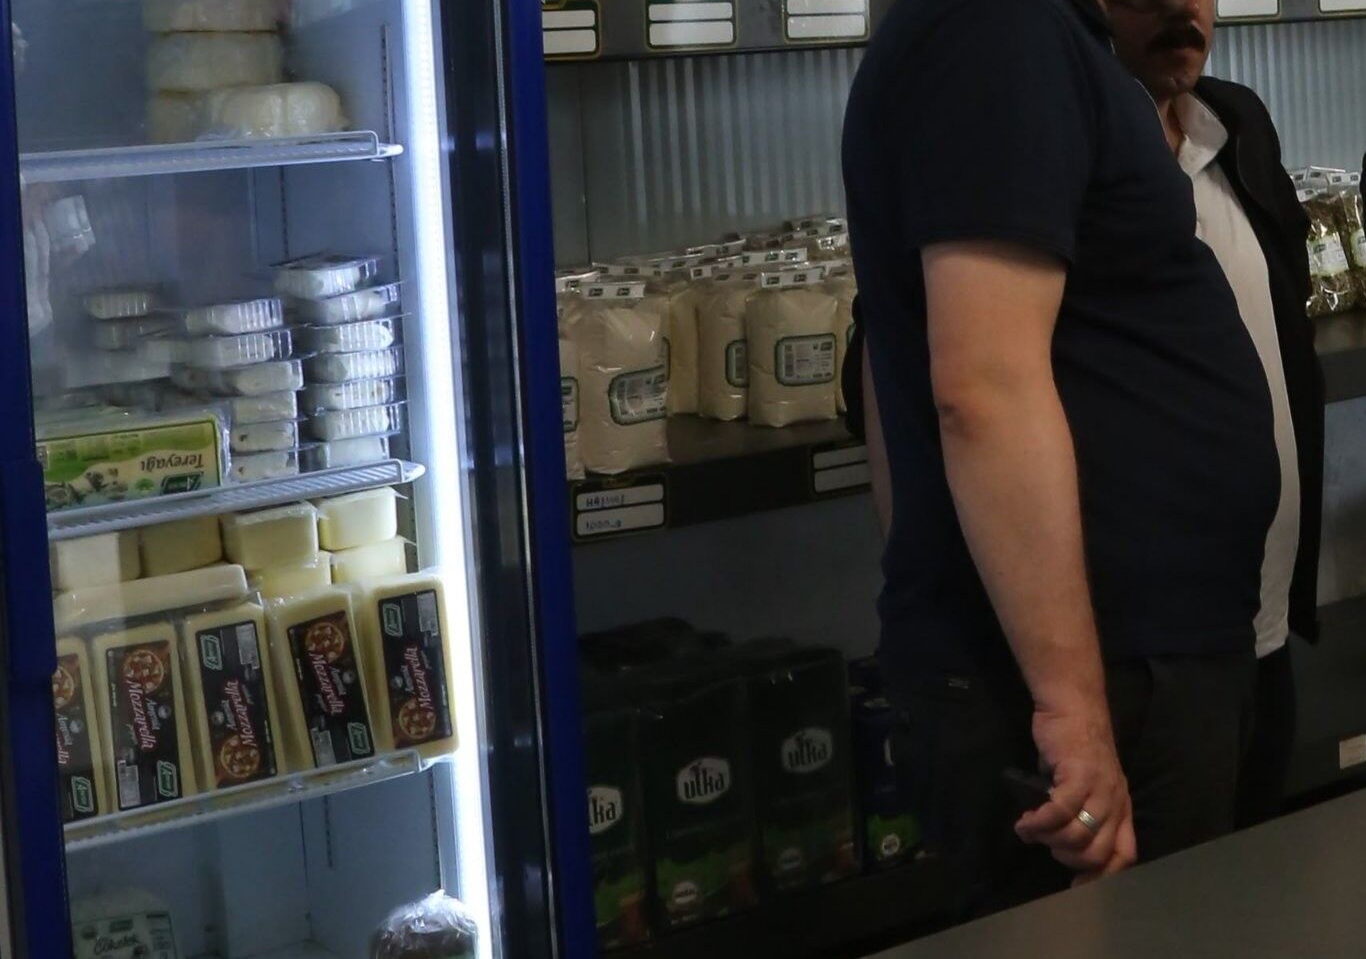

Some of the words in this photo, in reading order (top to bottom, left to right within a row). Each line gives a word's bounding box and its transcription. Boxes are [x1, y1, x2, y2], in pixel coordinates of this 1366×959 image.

[140, 453, 204, 473] Tereyağı
[307, 651, 345, 714] Mozzarella
[404, 645, 434, 709] Mozzarella
[125, 679, 159, 750] Mozzarella
[223, 678, 258, 748] Mozzarella
